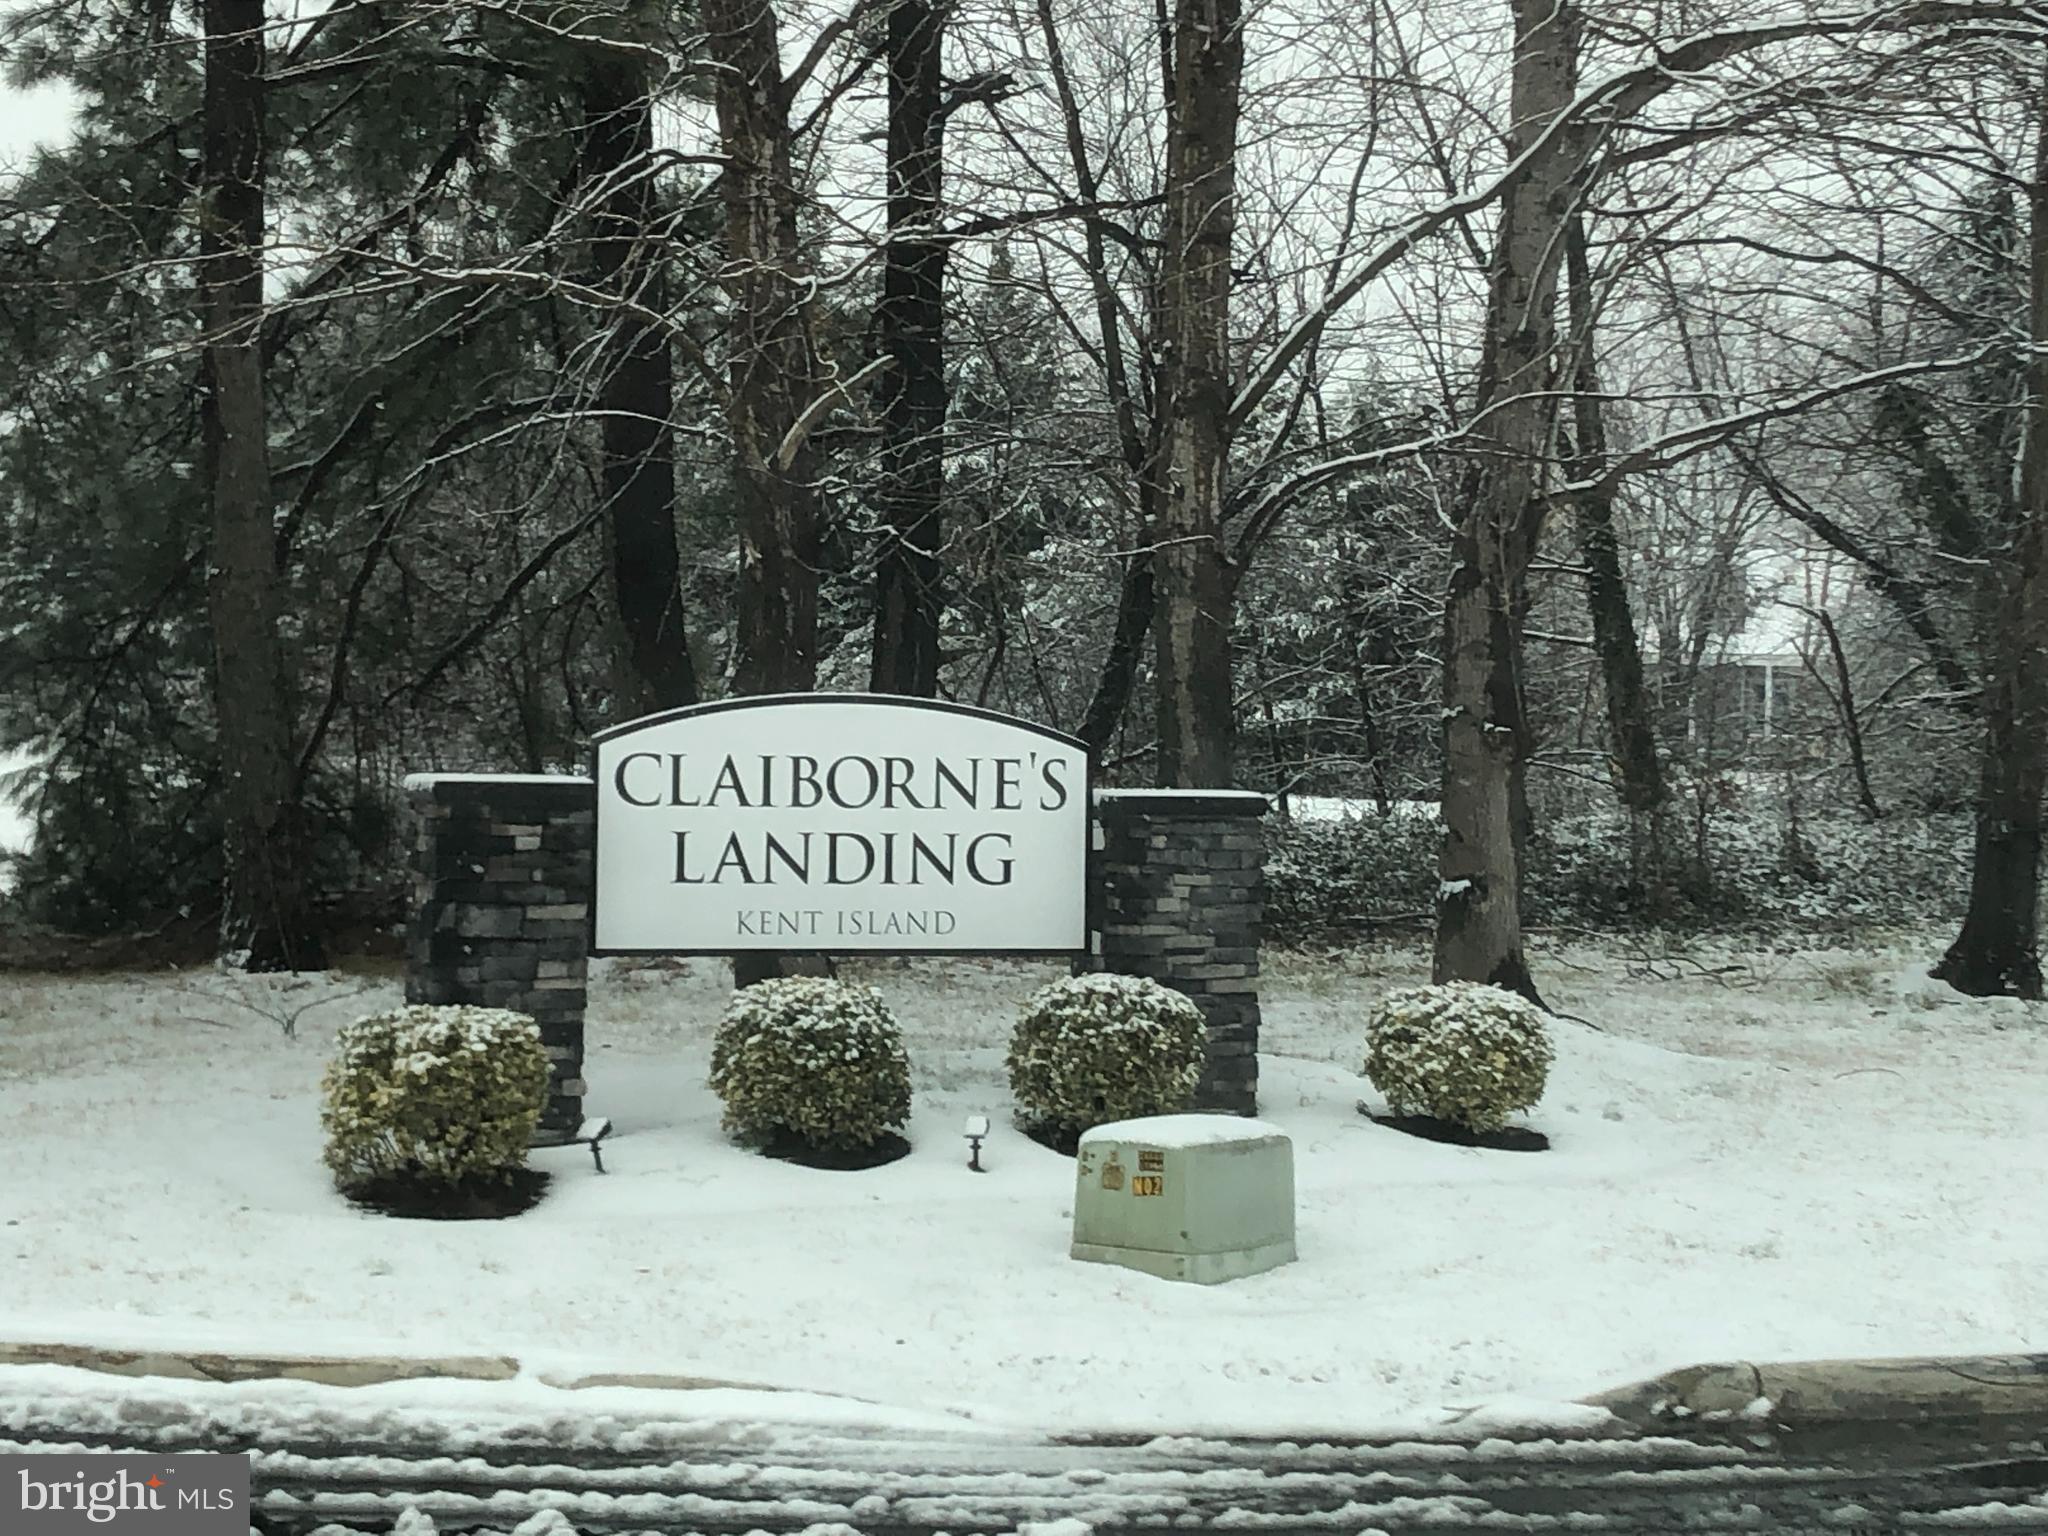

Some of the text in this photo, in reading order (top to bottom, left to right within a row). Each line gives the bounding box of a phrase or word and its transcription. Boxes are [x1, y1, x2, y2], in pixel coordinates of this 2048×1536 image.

[614, 752, 1068, 811] CLAIBORNE'S
[672, 831, 1016, 886] LANDING
[737, 911, 956, 936] KENT ISLAND
